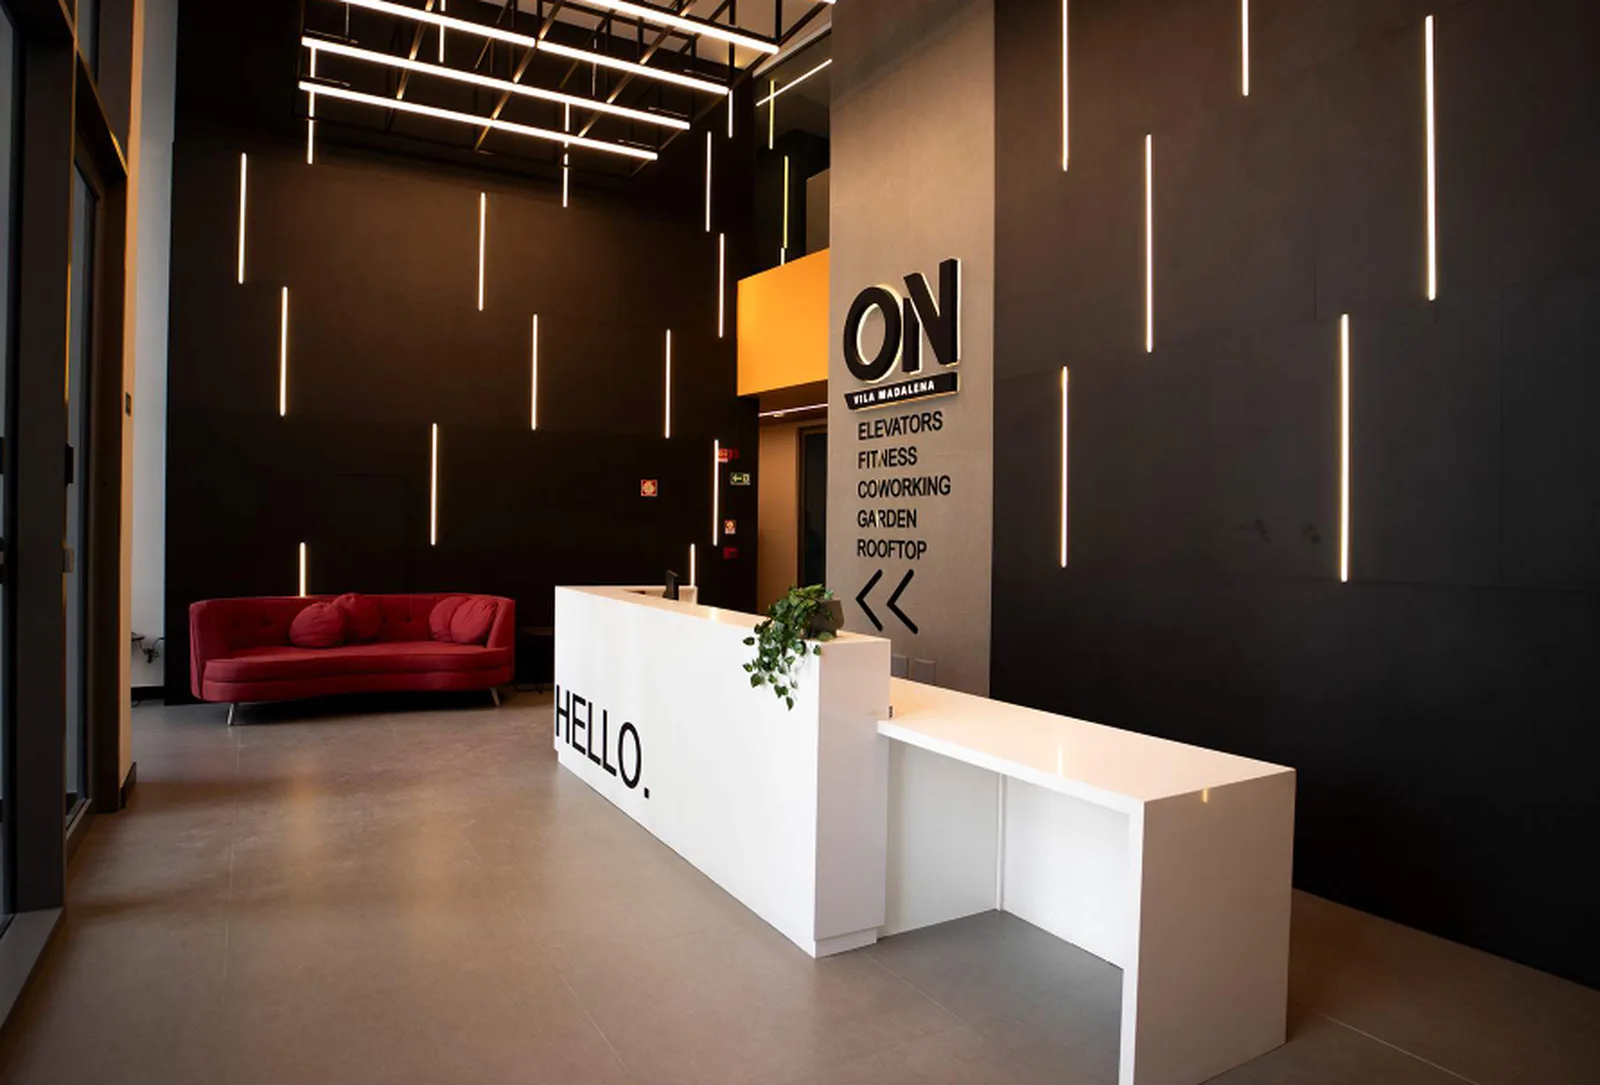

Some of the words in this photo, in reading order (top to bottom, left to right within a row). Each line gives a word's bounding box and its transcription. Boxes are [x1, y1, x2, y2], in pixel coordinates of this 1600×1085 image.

[843, 257, 959, 382] ON
[853, 391, 875, 405] VILA
[878, 380, 935, 400] MADALENA
[857, 411, 943, 440] ELEVATORS
[857, 446, 918, 469] FITNESS
[857, 475, 951, 498] COWORKING
[857, 508, 917, 529] GARDEN
[857, 539, 927, 560] ROOFTOP
[556, 684, 650, 799] HELLO.
